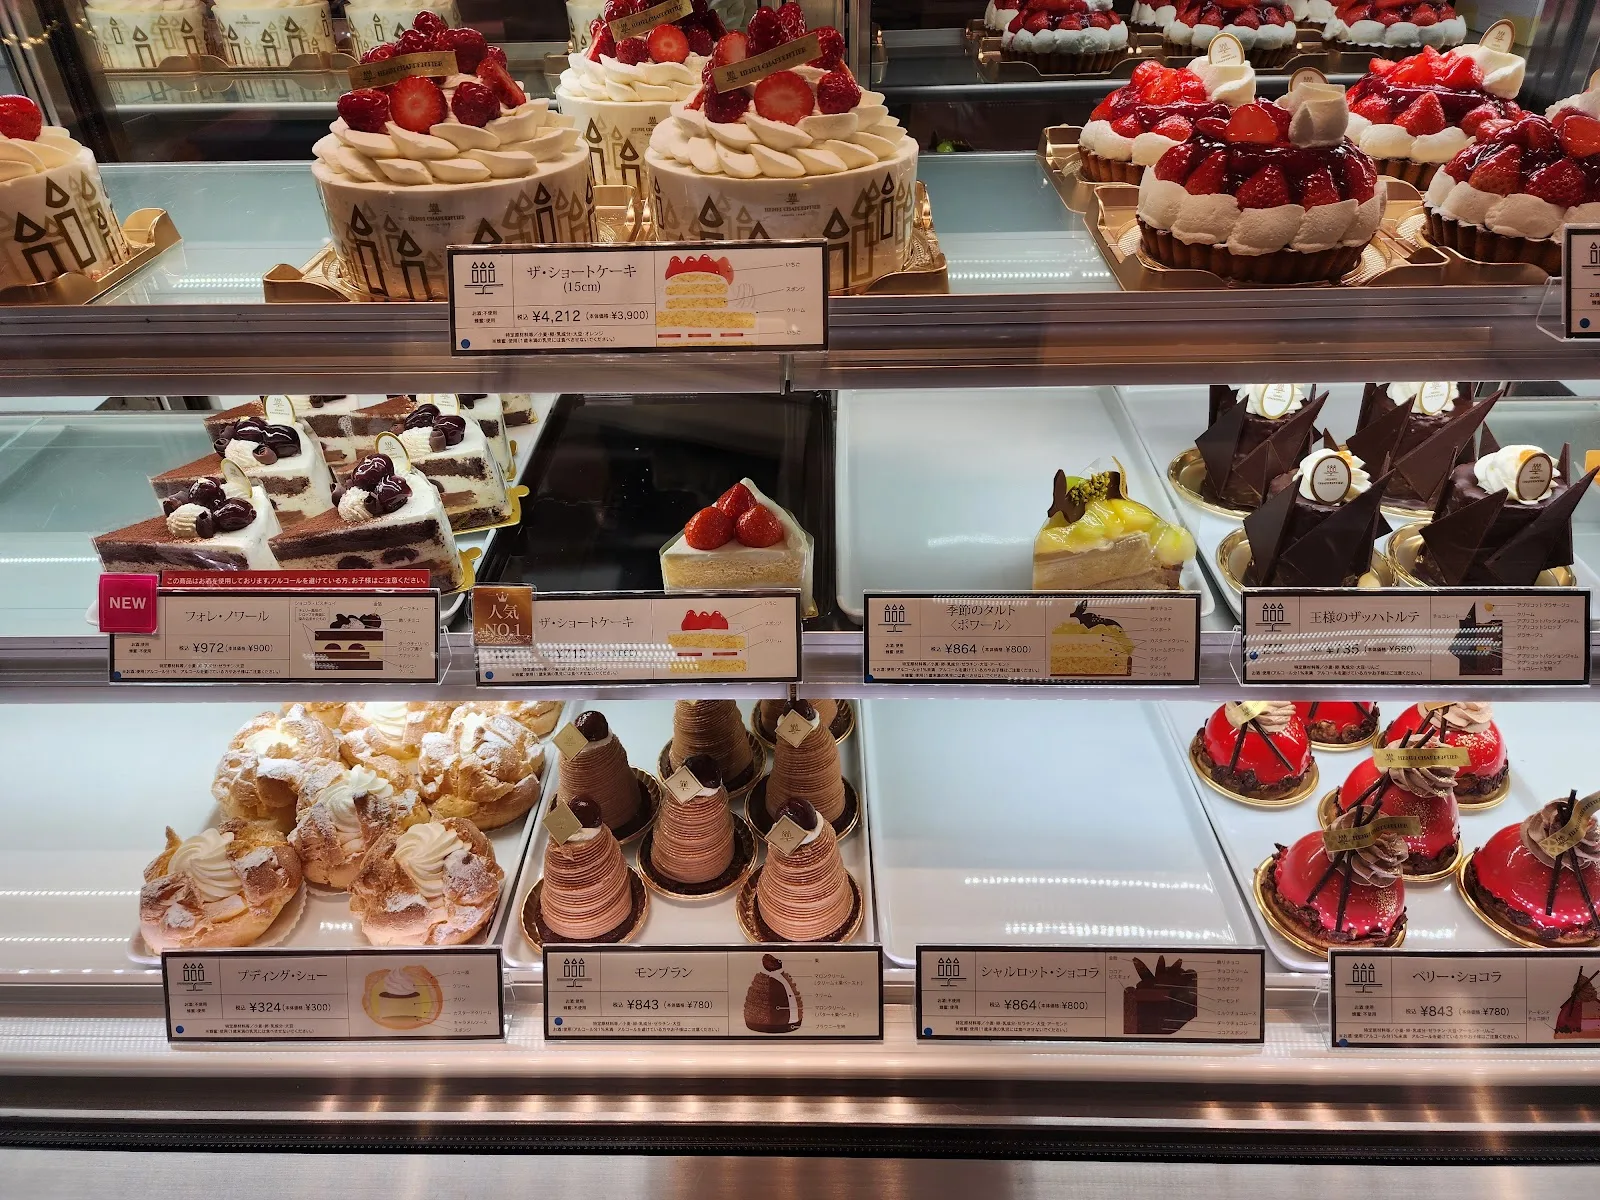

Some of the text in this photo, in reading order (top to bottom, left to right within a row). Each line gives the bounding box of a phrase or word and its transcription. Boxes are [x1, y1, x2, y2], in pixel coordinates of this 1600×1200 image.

[527, 265, 637, 279] ザ・ショートケーキ
[563, 280, 601, 294] (15cm)
[532, 310, 581, 324] ¥4,212
[109, 597, 147, 610] NEW
[946, 603, 1016, 617] 季節のタルト
[185, 609, 269, 623] フォレ・ノワール
[487, 604, 520, 620] 人気
[1309, 610, 1420, 624] 王様のザッハトルテ
[538, 616, 635, 629] ザ・ショートケーキ
[484, 623, 521, 637] NO.1
[192, 643, 224, 653] ¥972
[944, 643, 977, 654] ¥864
[237, 969, 328, 983] プディング・シュー
[634, 966, 693, 979] モンブラン
[980, 965, 1100, 979] シャルロット・ショコラ
[1412, 971, 1502, 983] ベリー・ショコラ
[249, 1002, 281, 1013] ¥324
[627, 999, 659, 1010] ¥843
[1004, 999, 1037, 1011] ¥864
[1420, 1005, 1454, 1017] ¥843
